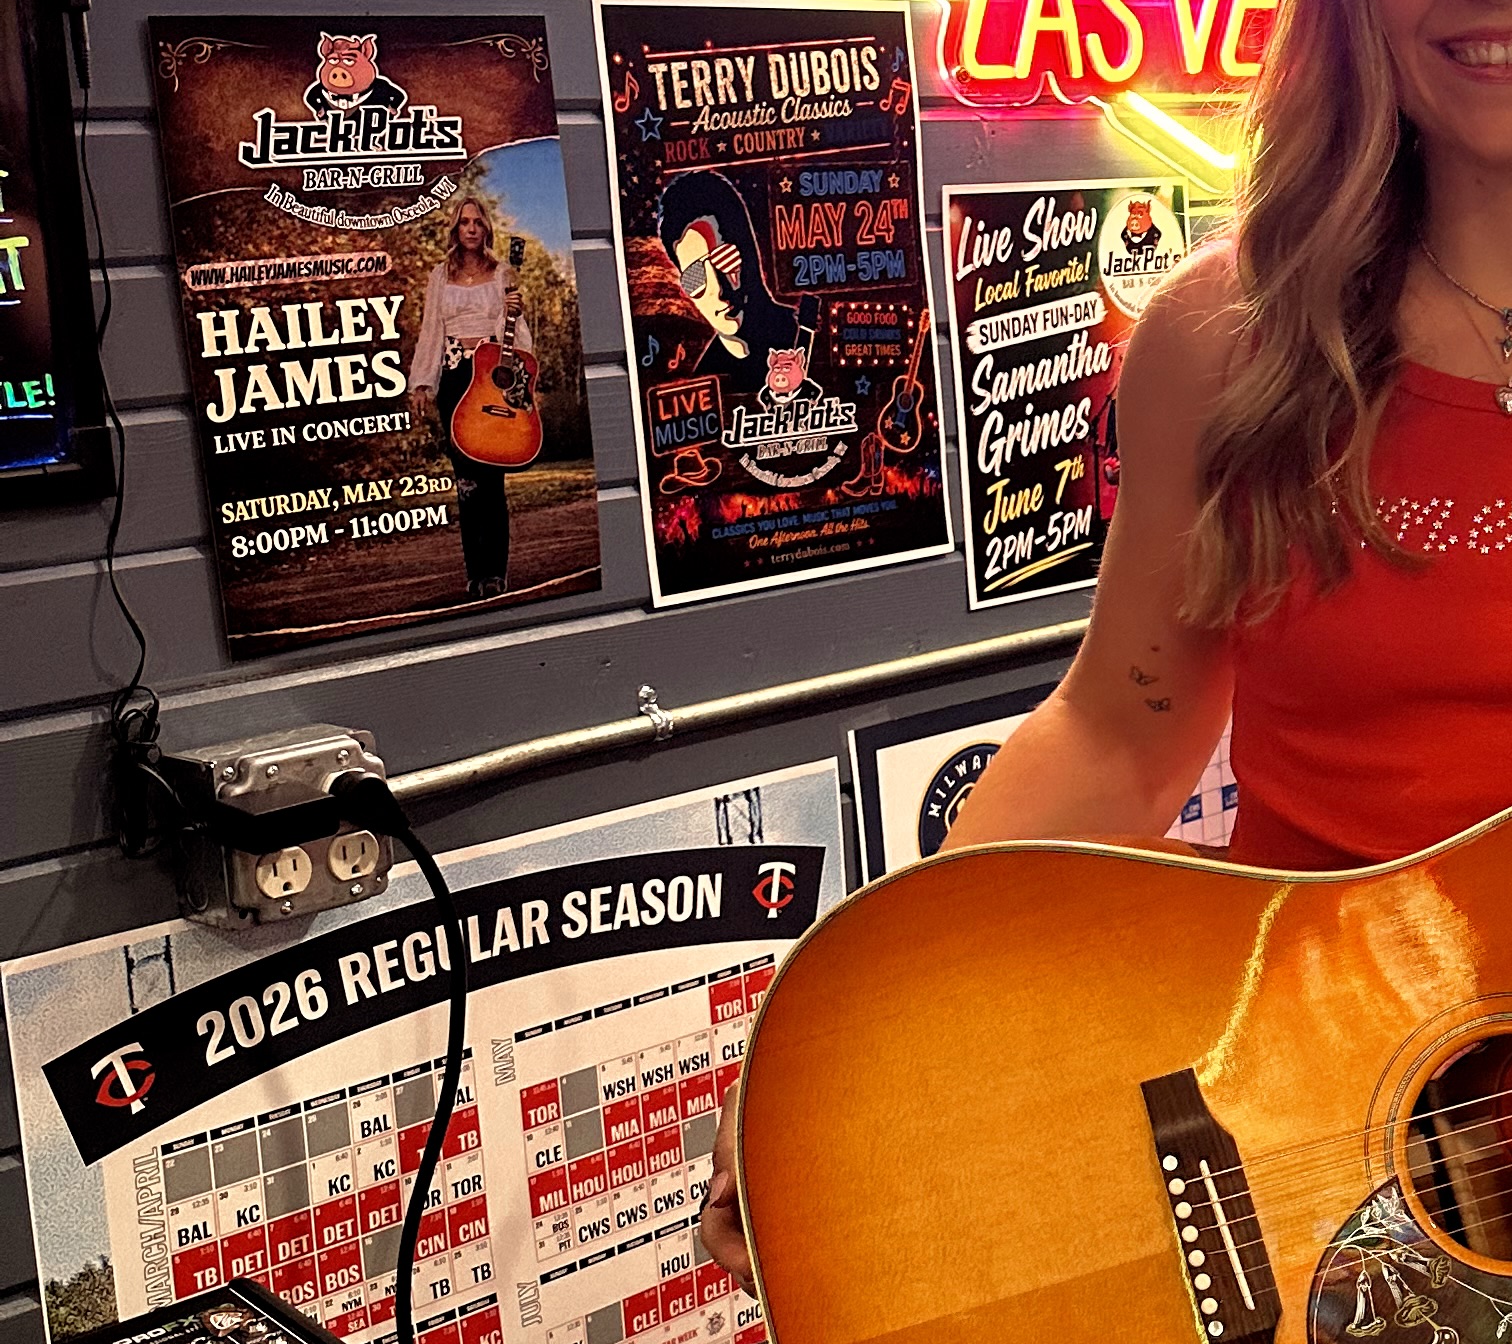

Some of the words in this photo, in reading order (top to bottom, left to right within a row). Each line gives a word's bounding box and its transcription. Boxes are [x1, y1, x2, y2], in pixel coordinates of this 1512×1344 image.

[647, 55, 755, 112] TERRY
[768, 45, 881, 100] DUBOIS
[690, 104, 778, 136] Acoustic
[780, 95, 854, 124] Classics
[663, 138, 711, 163] ROCK
[732, 127, 805, 155] COUNTRY
[303, 164, 424, 192] BAR-N-GRILL
[799, 169, 884, 197] SUNDAY
[264, 183, 283, 207] In
[282, 191, 336, 228] Beautiful
[336, 214, 394, 230] downtown
[391, 194, 440, 224] Osceola,
[430, 175, 458, 202] WI
[775, 201, 847, 251] MAY
[854, 198, 909, 246] 24TH
[955, 215, 1014, 284] Live
[1020, 196, 1098, 263] Show
[190, 254, 388, 288] WWW.HAILEYJAMESMUSIC.COM
[792, 249, 907, 287] 2PM-5PM
[974, 274, 1021, 313] Local
[1023, 251, 1093, 296] Favorite!
[197, 294, 405, 358] HAILEY
[846, 311, 872, 325] GOOD
[874, 312, 898, 326] FOOD
[978, 312, 1040, 347] SUNDAY
[1043, 297, 1097, 332] FUN-DAY
[845, 343, 873, 356] GREAT
[874, 343, 902, 356] TIMES
[969, 329, 1112, 417] Samantha
[206, 349, 408, 424] JAMES
[656, 388, 713, 421] LIVE
[213, 428, 266, 455] LIVE
[272, 426, 297, 448] IN
[302, 410, 412, 443] CONCERT!
[655, 412, 719, 448] MUSIC
[977, 396, 1093, 478] Grimes
[220, 491, 339, 525] SATURDAY,
[342, 478, 395, 507] MAY
[399, 472, 453, 499] 23RD
[983, 476, 1045, 537] June
[1053, 453, 1086, 506] 7th
[230, 523, 329, 559] 8:00PM
[348, 504, 450, 540] 11:00PM
[983, 504, 1094, 582] 2PM-5PM
[195, 966, 329, 1068] 2026
[338, 898, 551, 1007] REGULAR
[561, 871, 723, 940] SEASON
[490, 1036, 517, 1087] MAY
[602, 1075, 637, 1101] WSH
[360, 1113, 392, 1140] BAL
[534, 1144, 563, 1170] CLE
[610, 1120, 641, 1145] MIA
[328, 1173, 352, 1197] KC
[457, 1129, 479, 1151] TB
[450, 1173, 483, 1199] TOR
[537, 1188, 568, 1214] MIL
[571, 1174, 605, 1201] HOU
[230, 1249, 266, 1278] DET
[416, 1231, 446, 1258] CIN
[577, 1217, 612, 1245] CWS
[324, 1263, 362, 1291] BOS
[341, 1296, 363, 1314] NYM
[516, 1280, 543, 1329] JULY
